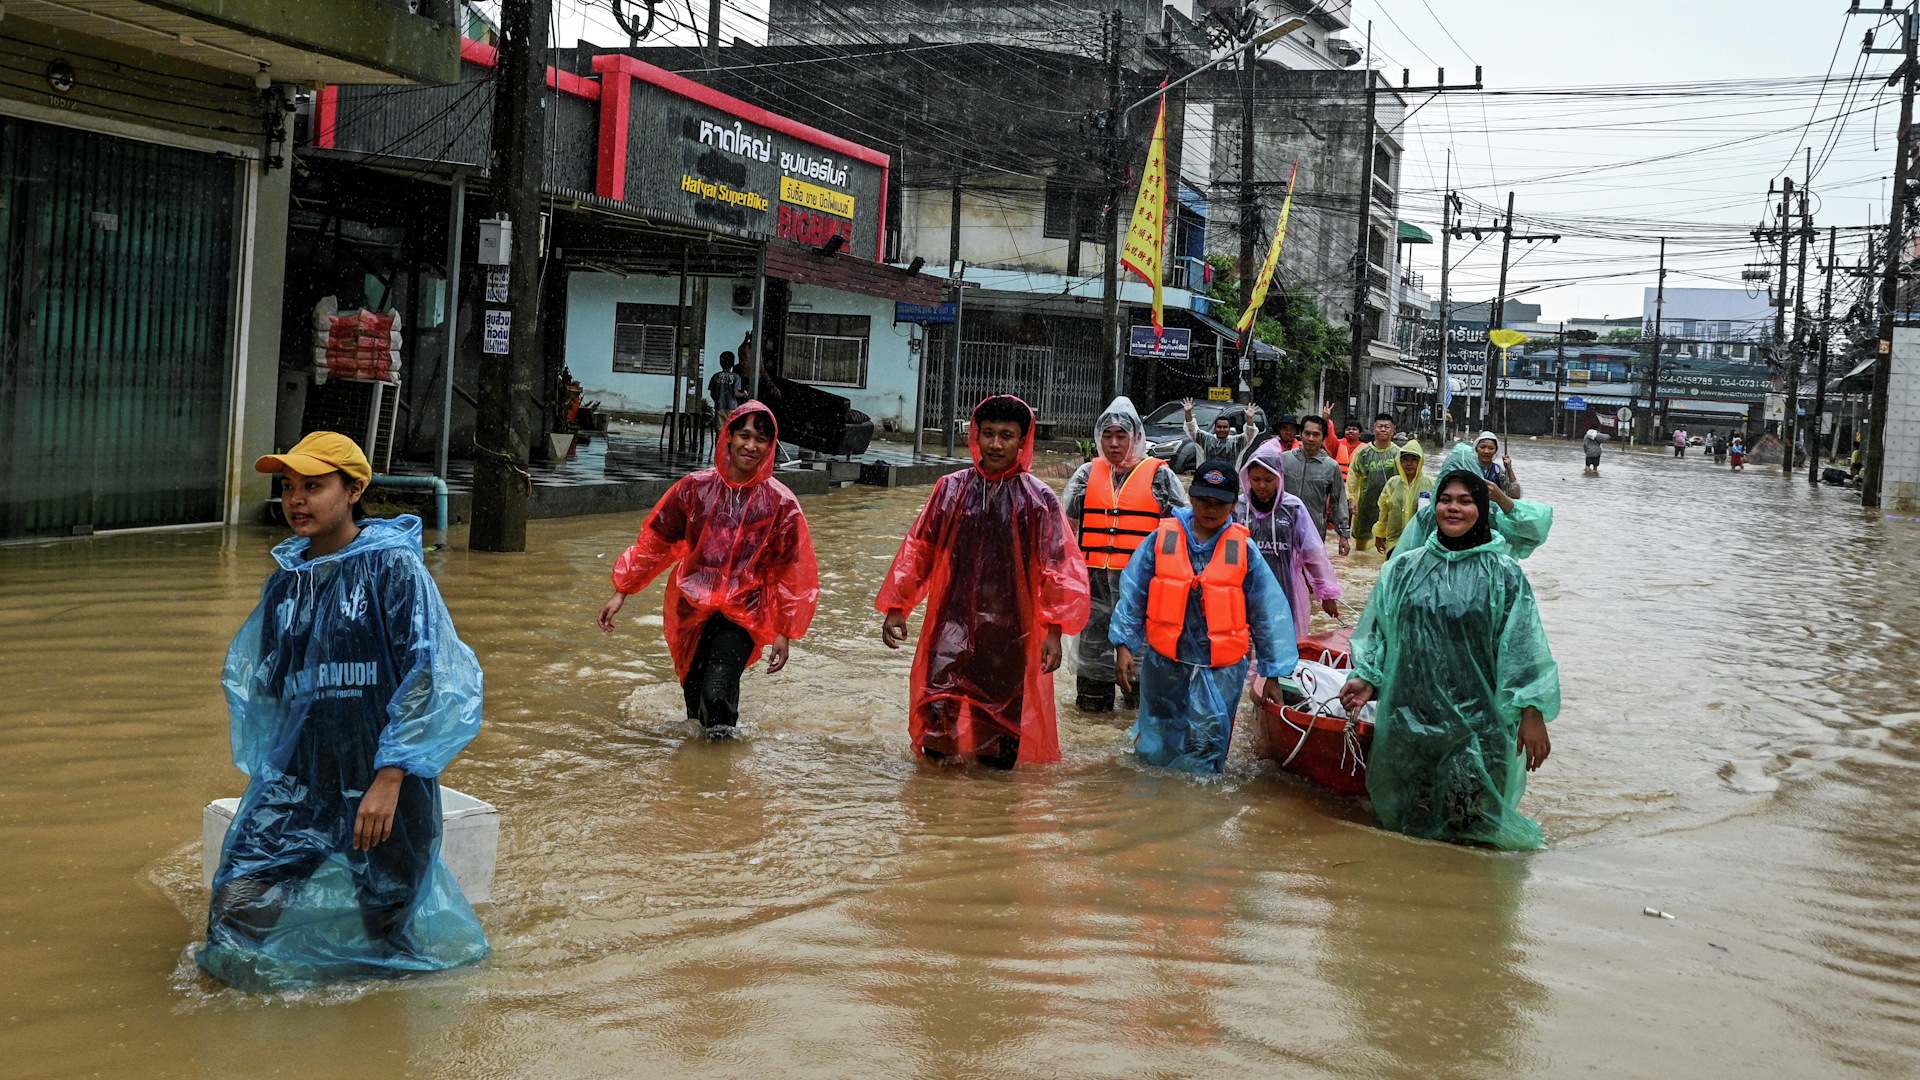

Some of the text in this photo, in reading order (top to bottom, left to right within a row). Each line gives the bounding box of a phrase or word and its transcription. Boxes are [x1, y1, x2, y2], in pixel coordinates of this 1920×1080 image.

[699, 120, 772, 163] หาดใหญ่
[681, 174, 769, 212] Hatyai SuperBike
[786, 182, 804, 201] รับซื้อ
[805, 192, 817, 206] ขาย
[777, 205, 853, 253] BIGBIKE
[486, 311, 510, 328] สูบส้วม
[486, 326, 508, 340] ท่อตัน
[335, 688, 363, 699] PROGRAM
